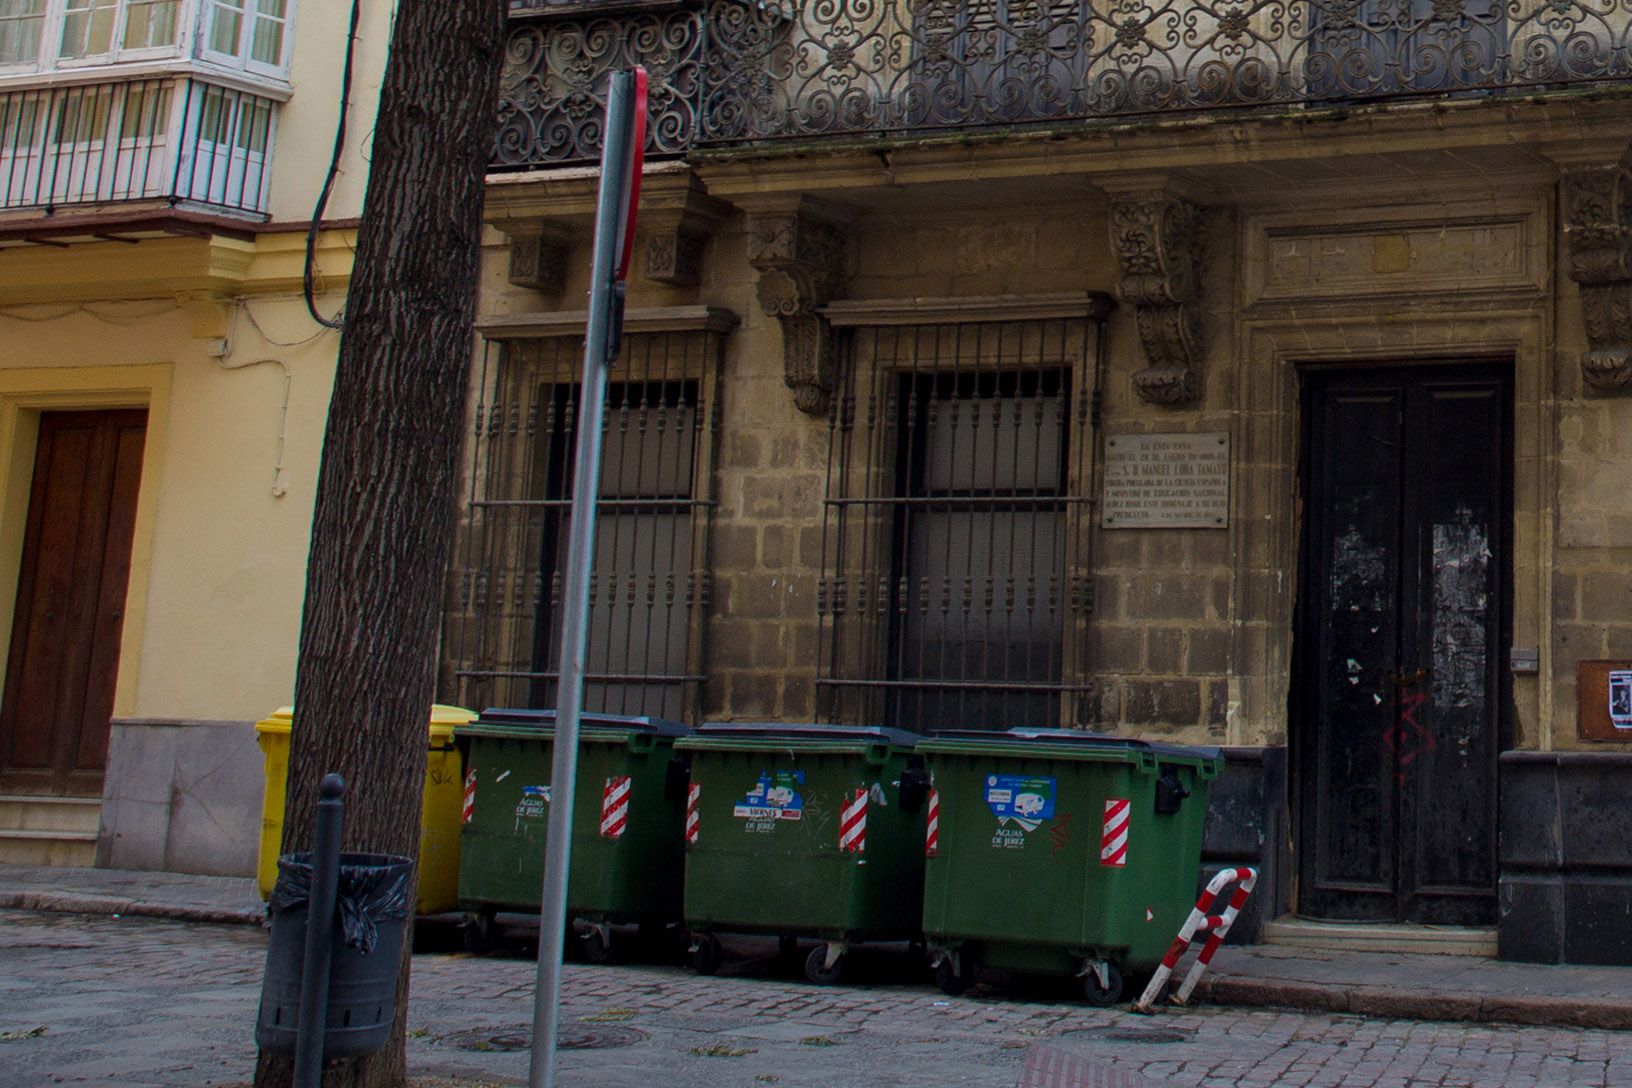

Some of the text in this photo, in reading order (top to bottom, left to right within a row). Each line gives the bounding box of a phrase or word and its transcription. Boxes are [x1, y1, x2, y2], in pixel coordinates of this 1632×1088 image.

[1142, 464, 1170, 476] MANUEL
[1197, 463, 1227, 475] TAMAYO
[520, 798, 543, 806] AGUAS
[526, 807, 544, 815] JEREZ
[756, 823, 776, 832] JEREZ
[995, 828, 1023, 837] AGUAS
[1004, 838, 1024, 847] JEREZ
